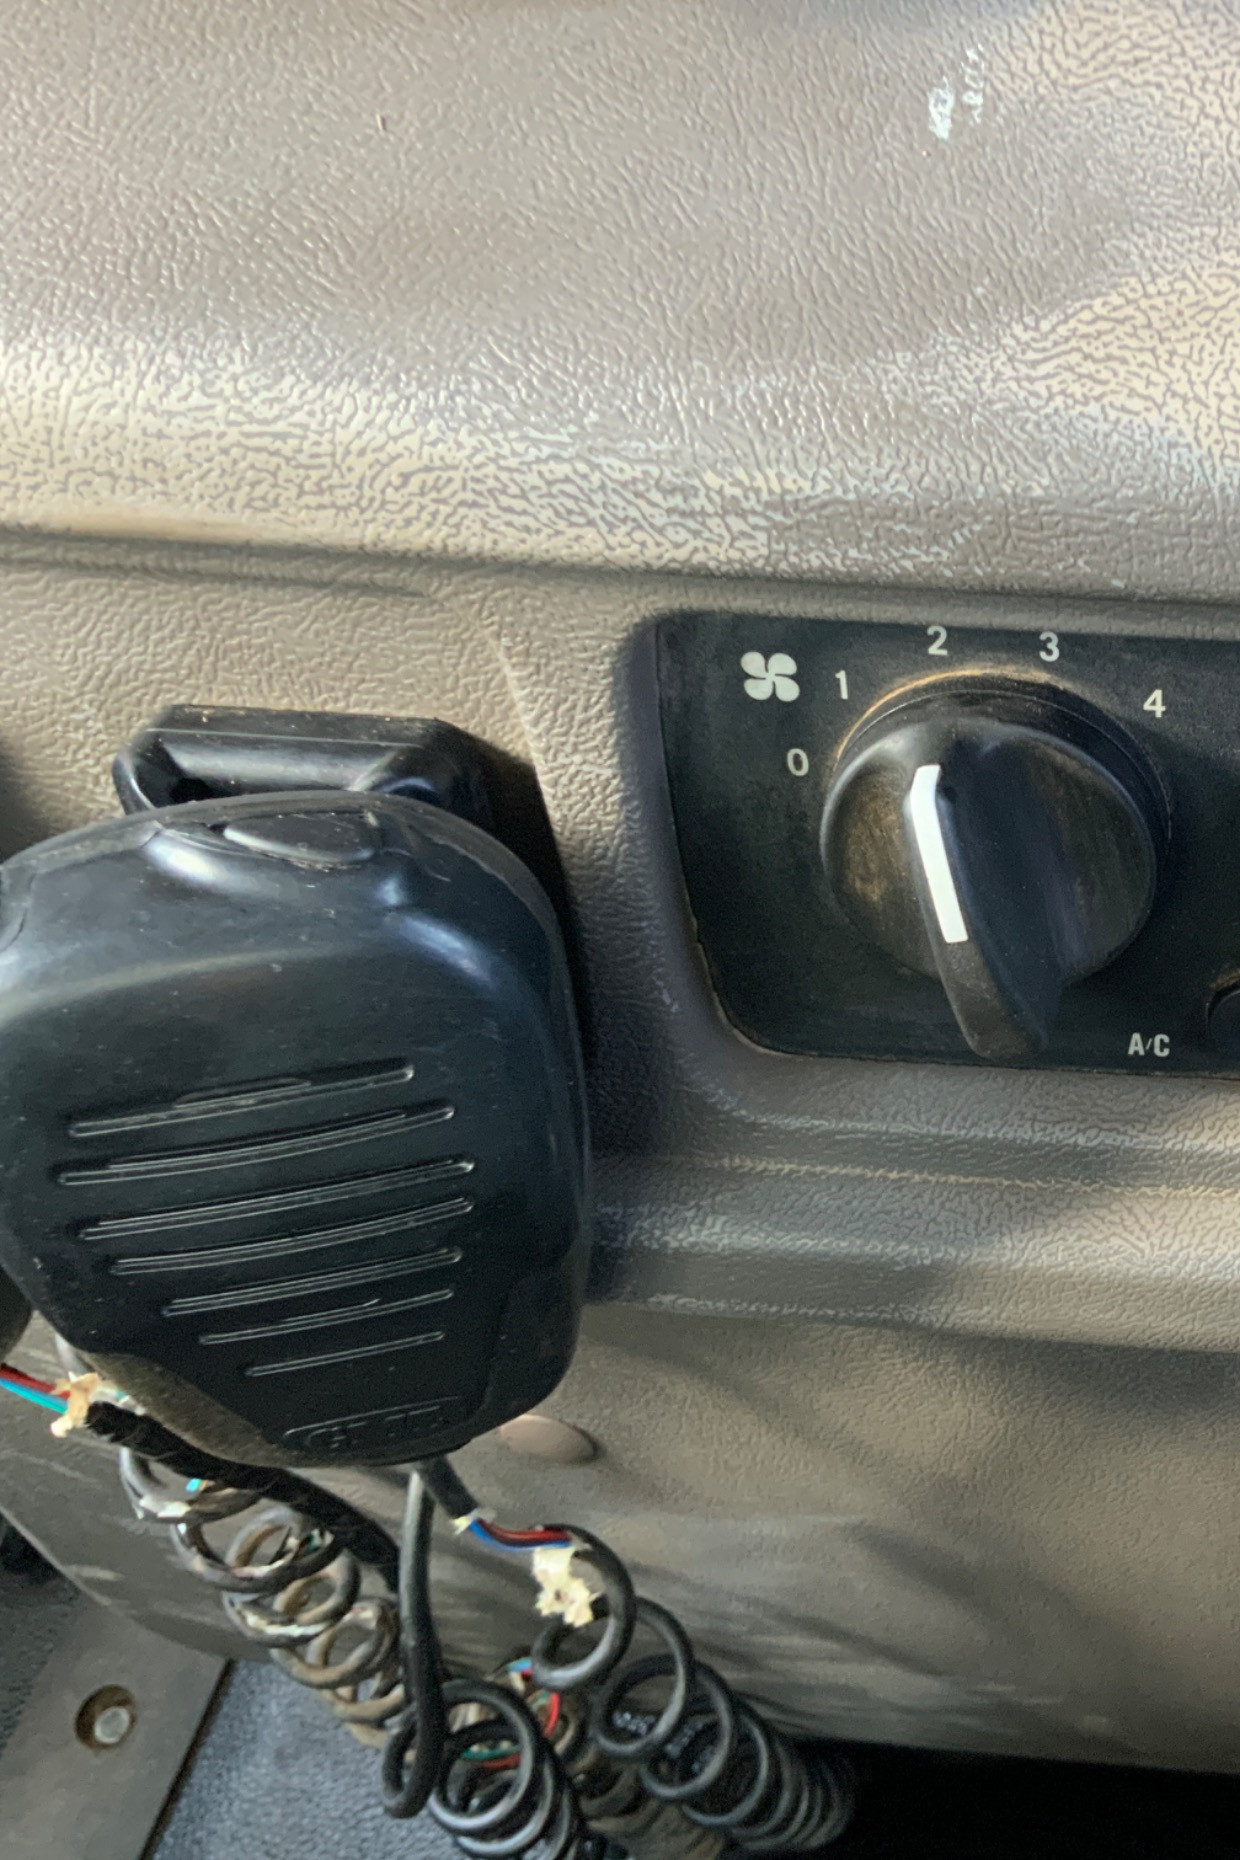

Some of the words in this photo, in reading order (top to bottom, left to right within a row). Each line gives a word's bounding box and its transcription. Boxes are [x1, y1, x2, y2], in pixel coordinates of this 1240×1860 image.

[927, 626, 948, 656] 2
[1038, 631, 1060, 662] 3
[835, 669, 848, 700] 1
[1142, 689, 1166, 718] 4
[786, 748, 809, 777] 0
[1127, 1032, 1170, 1057] A/C
